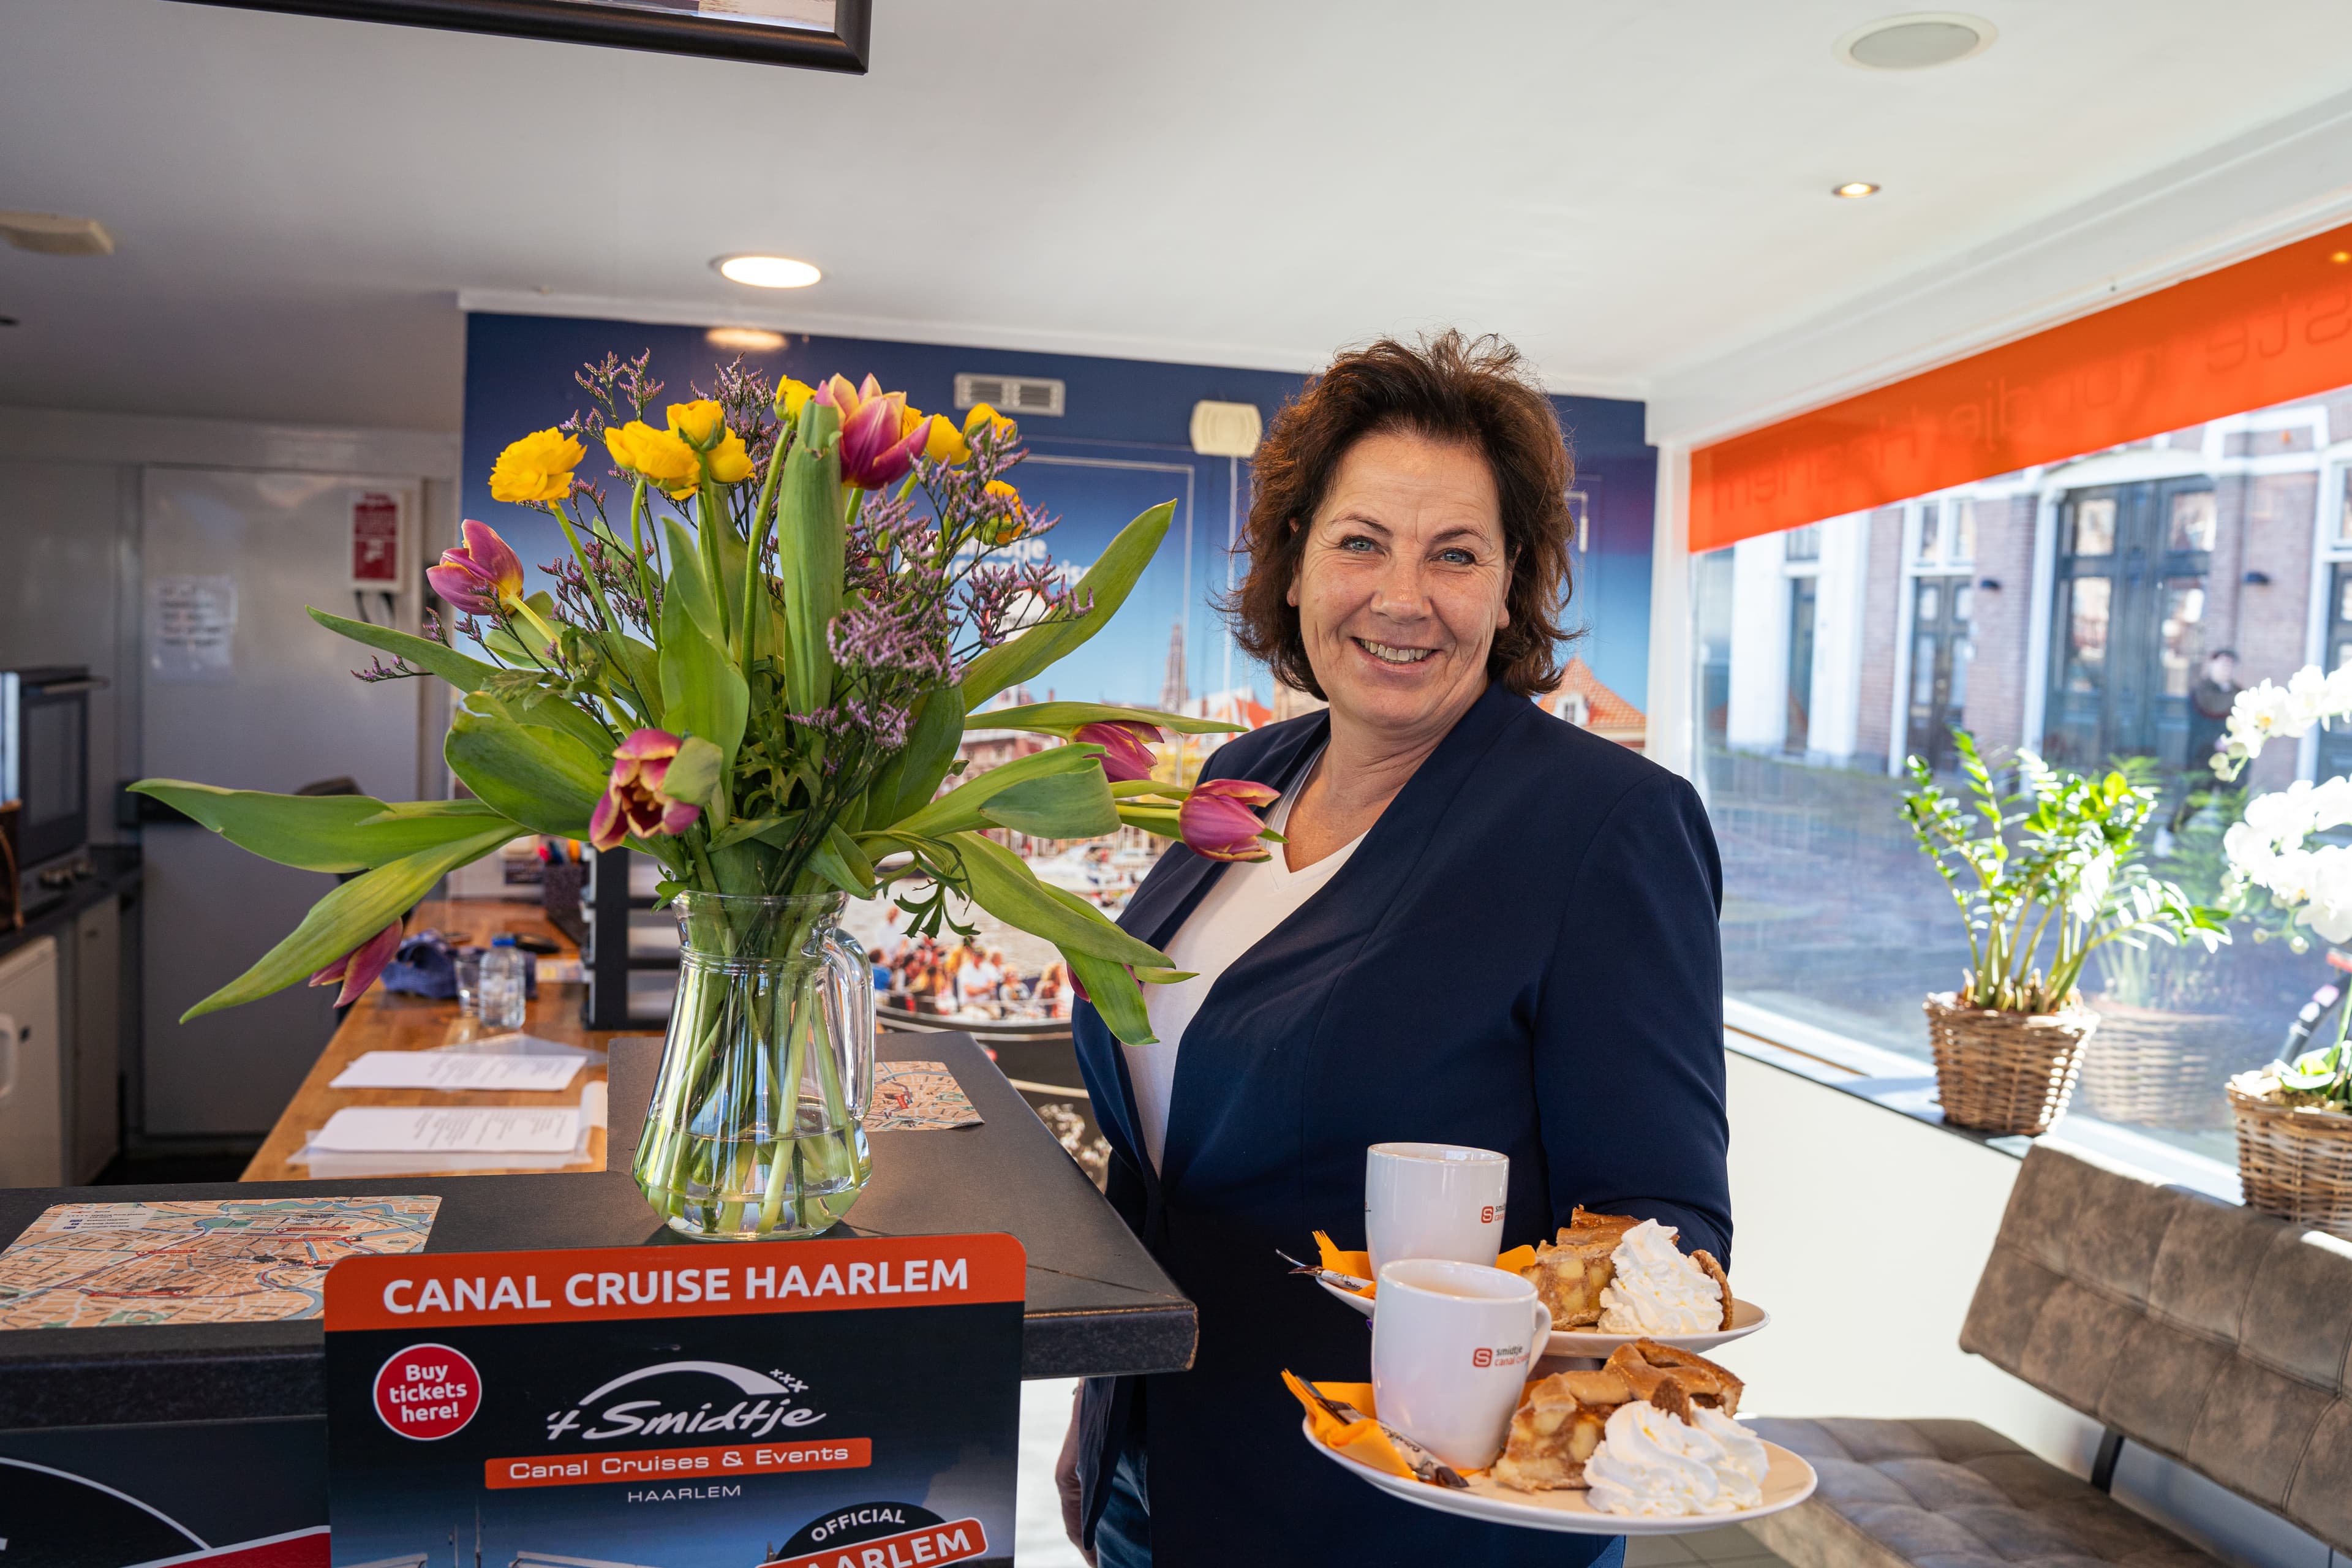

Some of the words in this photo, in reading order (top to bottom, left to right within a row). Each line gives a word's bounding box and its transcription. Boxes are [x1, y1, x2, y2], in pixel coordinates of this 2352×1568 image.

[383, 1276, 551, 1314] CANAL
[565, 1268, 731, 1308] CRUISE
[746, 1258, 968, 1300] HAARLEM
[405, 1365, 448, 1382] Buy
[389, 1382, 467, 1403] tickets
[401, 1402, 459, 1423] here!
[581, 1398, 826, 1439] Smidtje
[510, 1461, 588, 1479] Canal
[601, 1454, 709, 1474] Cruises
[722, 1451, 744, 1467] &
[755, 1446, 848, 1465] Events
[628, 1485, 741, 1503] HAARLEM
[811, 1508, 906, 1543] OFFICIAL
